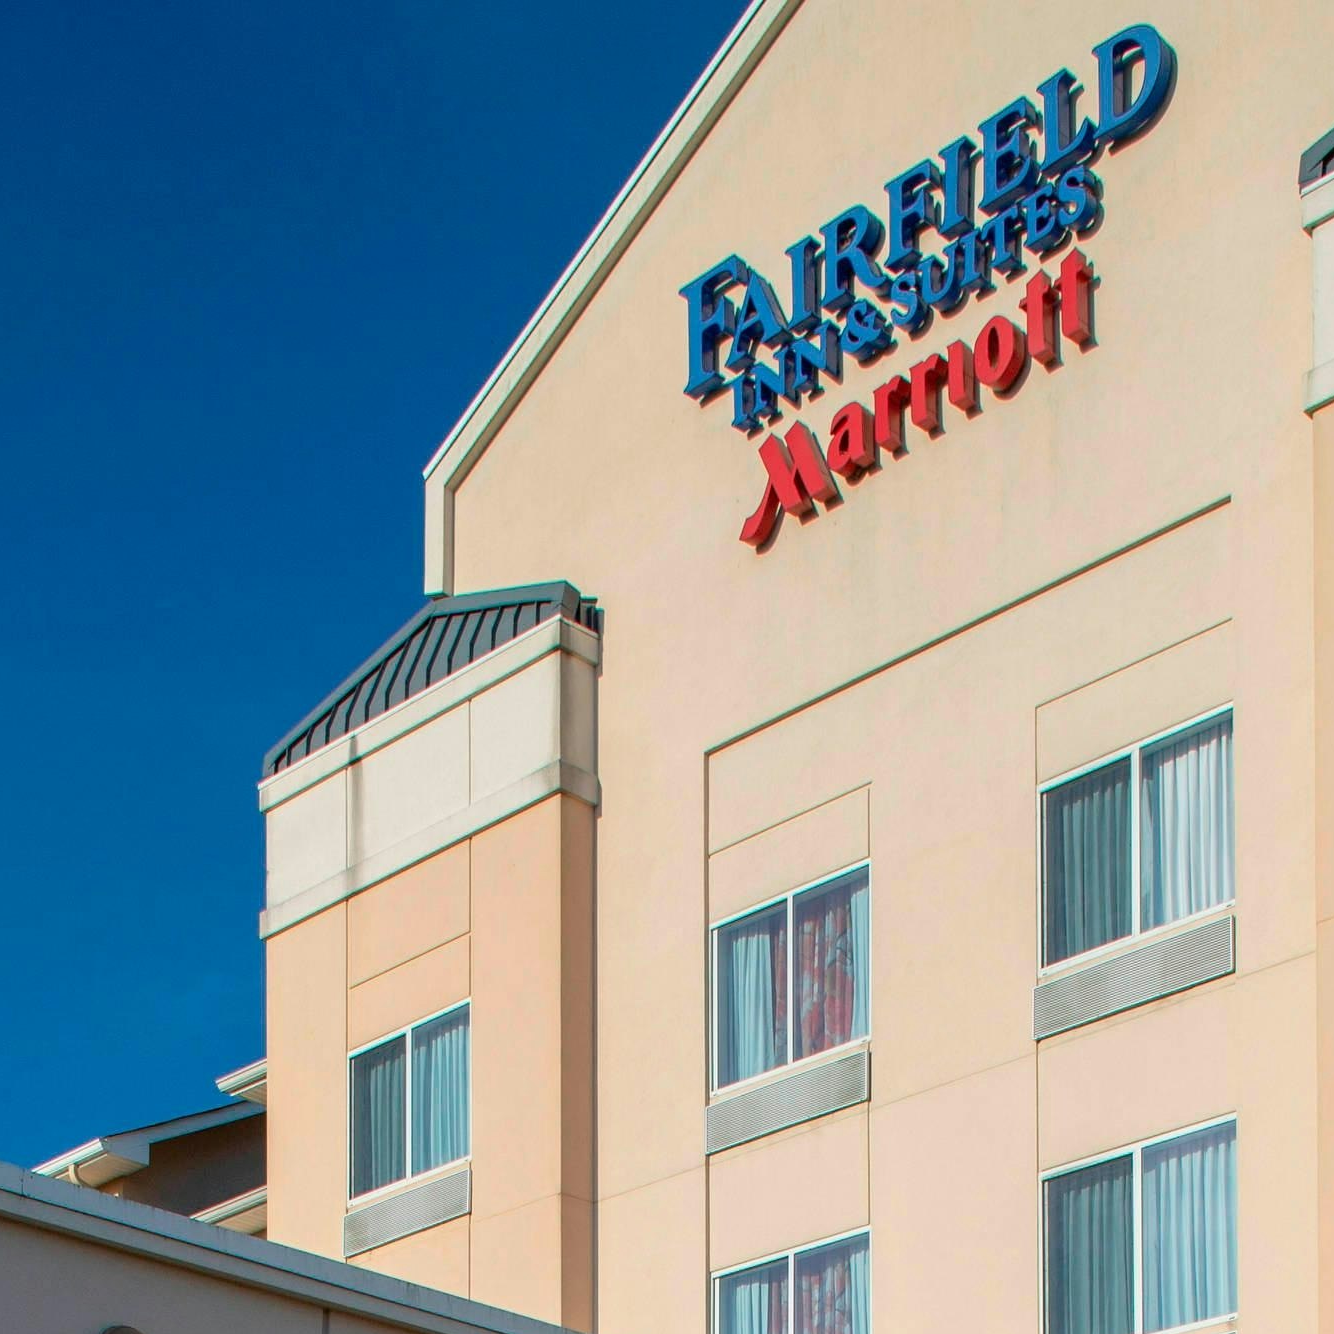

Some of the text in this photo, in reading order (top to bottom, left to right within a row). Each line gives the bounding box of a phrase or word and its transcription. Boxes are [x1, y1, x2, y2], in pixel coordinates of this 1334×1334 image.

[679, 24, 1178, 398] FAIRFIELD
[730, 165, 1102, 432] INN & SUITES
[739, 247, 1098, 547] Marriott
